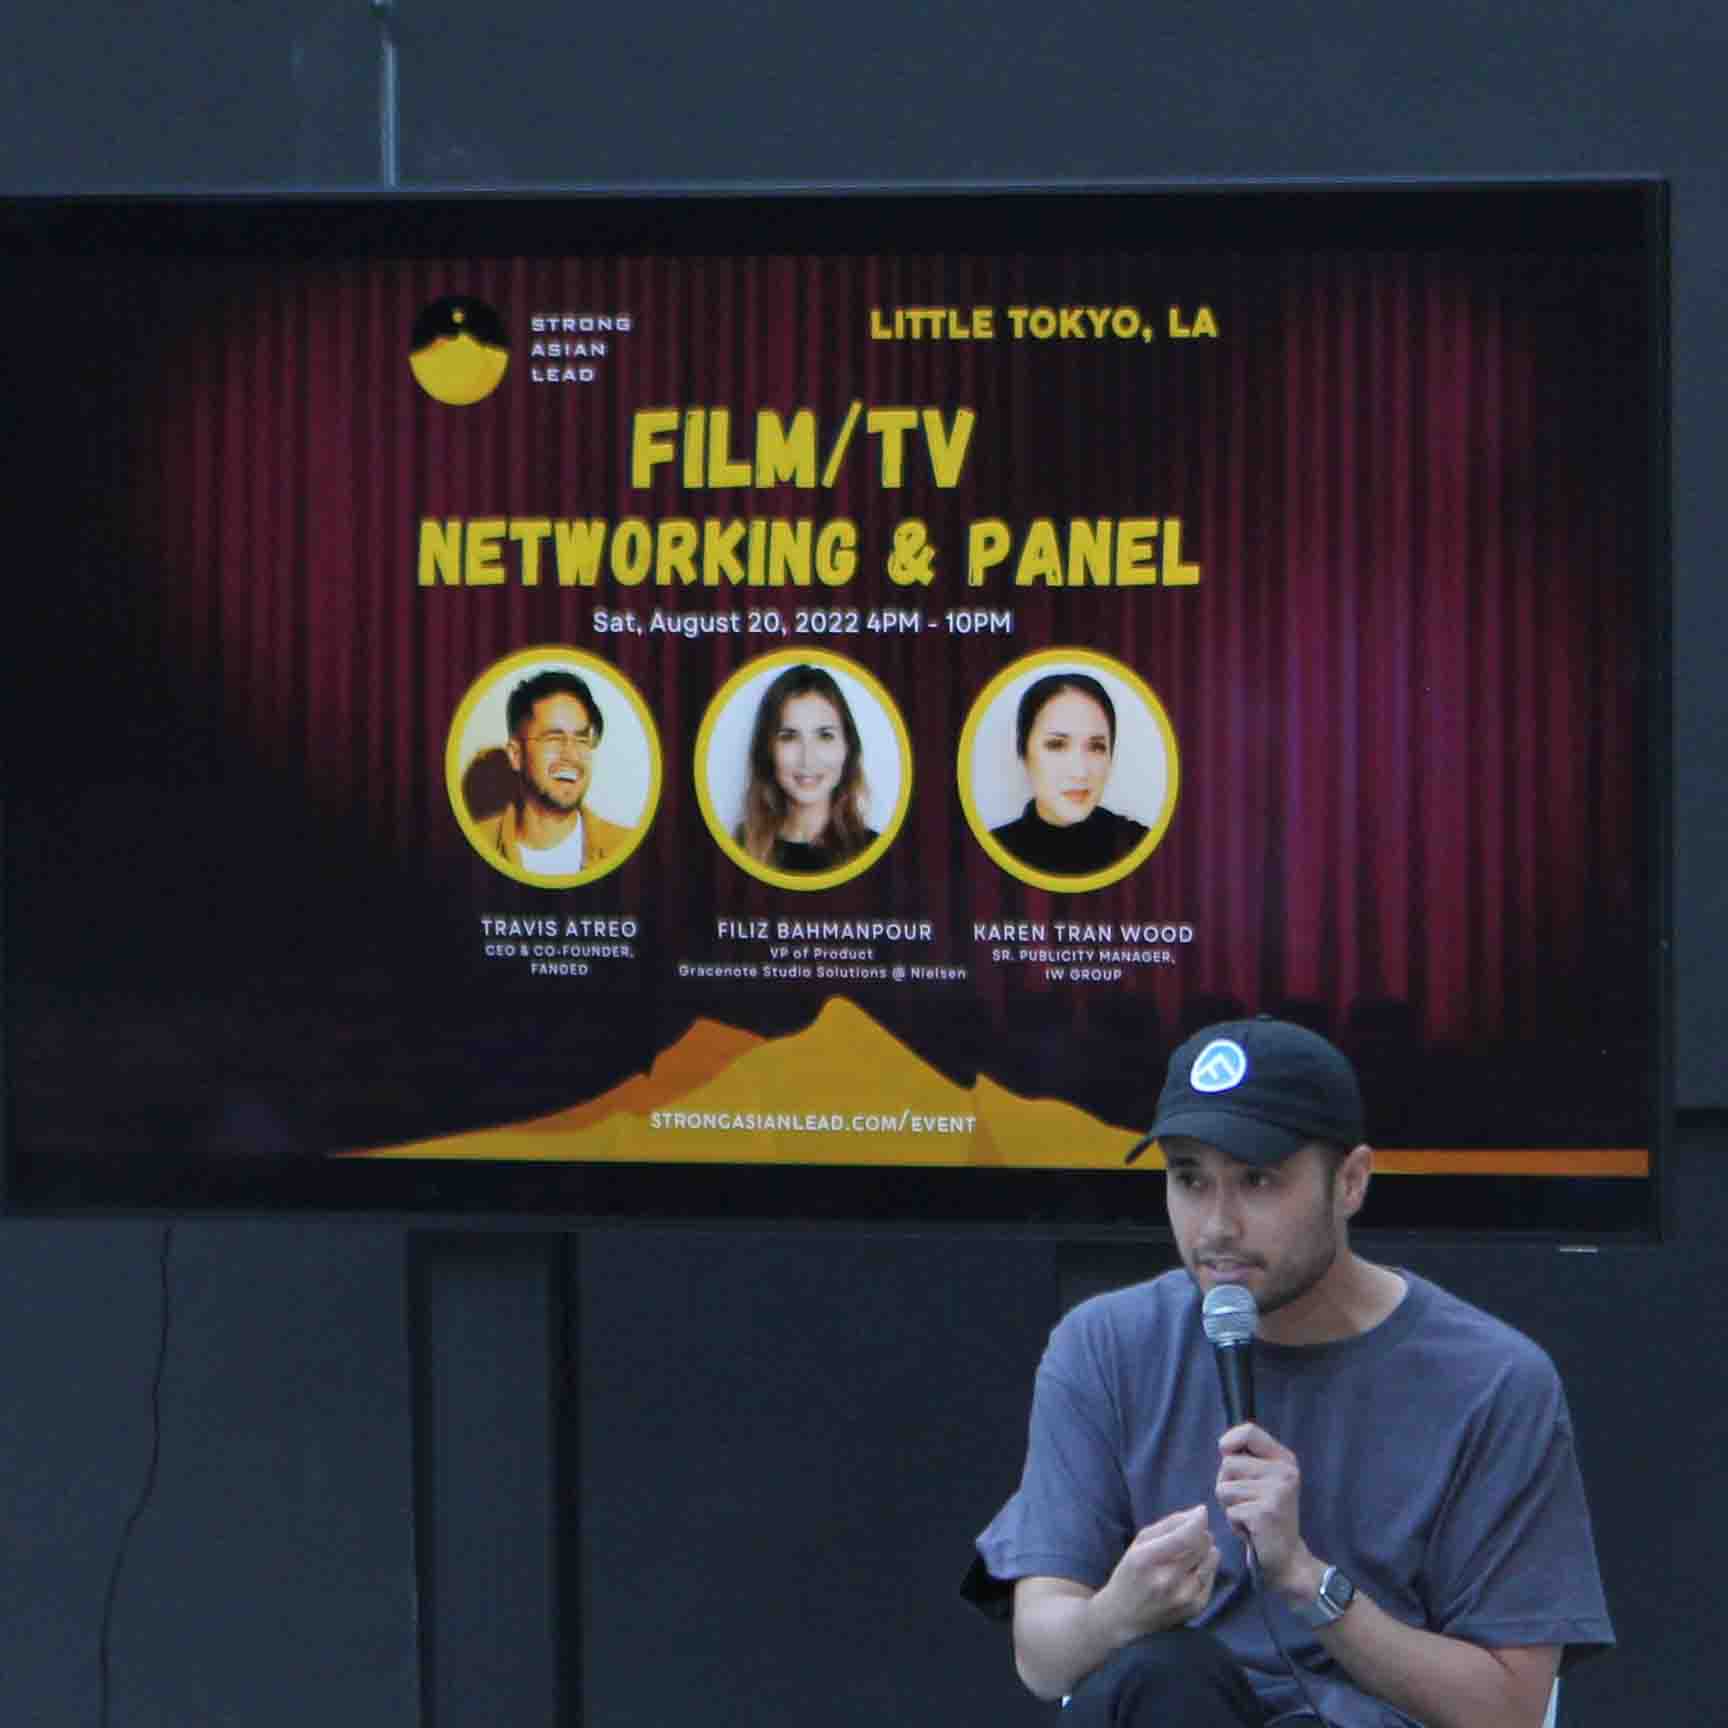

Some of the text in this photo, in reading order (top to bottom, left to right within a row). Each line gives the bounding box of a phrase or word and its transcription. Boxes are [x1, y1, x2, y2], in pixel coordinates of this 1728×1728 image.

[531, 316, 632, 331] STRONG
[871, 309, 1217, 343] LITTLE TOKYO, LA
[531, 343, 606, 357] ASIAN
[531, 368, 594, 382] LEAD
[631, 402, 975, 488] FILM/TV
[418, 518, 1200, 588] NETWORKING & PANEL
[593, 612, 643, 638] Sat,
[650, 610, 741, 639] August
[749, 611, 788, 637] 20,
[795, 611, 860, 634] 2022
[867, 611, 920, 634] 4PM
[945, 611, 1011, 634] 10PM
[481, 919, 637, 937] TRAVIS ATREO
[717, 922, 932, 940] FILIZ BAHMANPOUR
[974, 924, 1193, 943] KAREN TRAN WOOD
[485, 944, 515, 957] CEO
[770, 947, 873, 960] VP of Product
[1020, 950, 1093, 962] PUBLICITY
[679, 965, 757, 978] Gracenote
[763, 965, 811, 978] Studio
[817, 966, 887, 979] Solutions
[911, 967, 966, 980] Nielsen
[1070, 969, 1122, 981] GROUP
[649, 1109, 976, 1133] STRONGASIANLEAD.COM/EVENT
